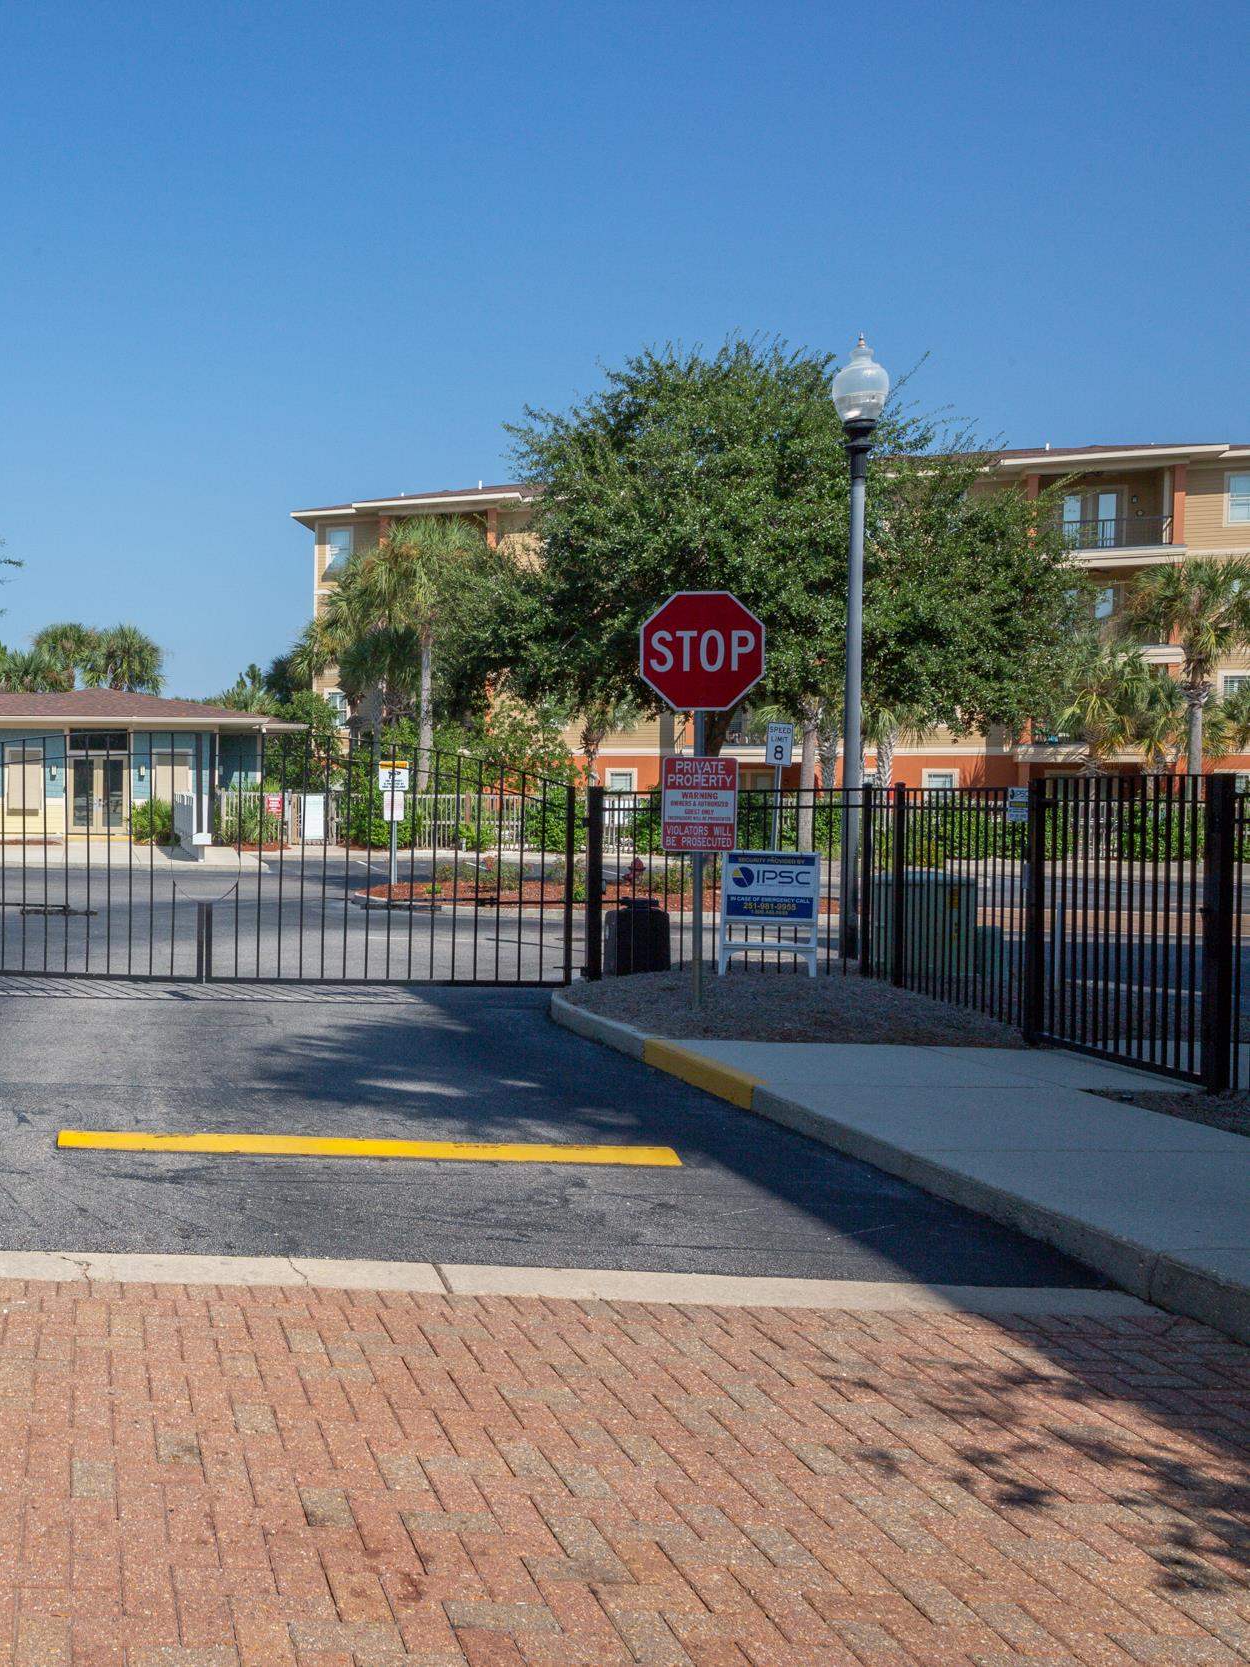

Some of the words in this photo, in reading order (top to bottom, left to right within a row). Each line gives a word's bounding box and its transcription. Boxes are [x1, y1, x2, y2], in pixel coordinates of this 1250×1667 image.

[650, 629, 755, 672] STOP
[769, 726, 792, 734] SPEED
[774, 745, 784, 760] 8
[675, 761, 726, 774] PRIVATE
[667, 774, 733, 787] PROPERTY
[681, 791, 719, 800] WARNING
[666, 825, 709, 836] VIOLATORS
[713, 826, 732, 837] WILL
[665, 836, 677, 846] BE
[681, 837, 732, 847] PROSECUTED
[756, 870, 811, 885] IPSC
